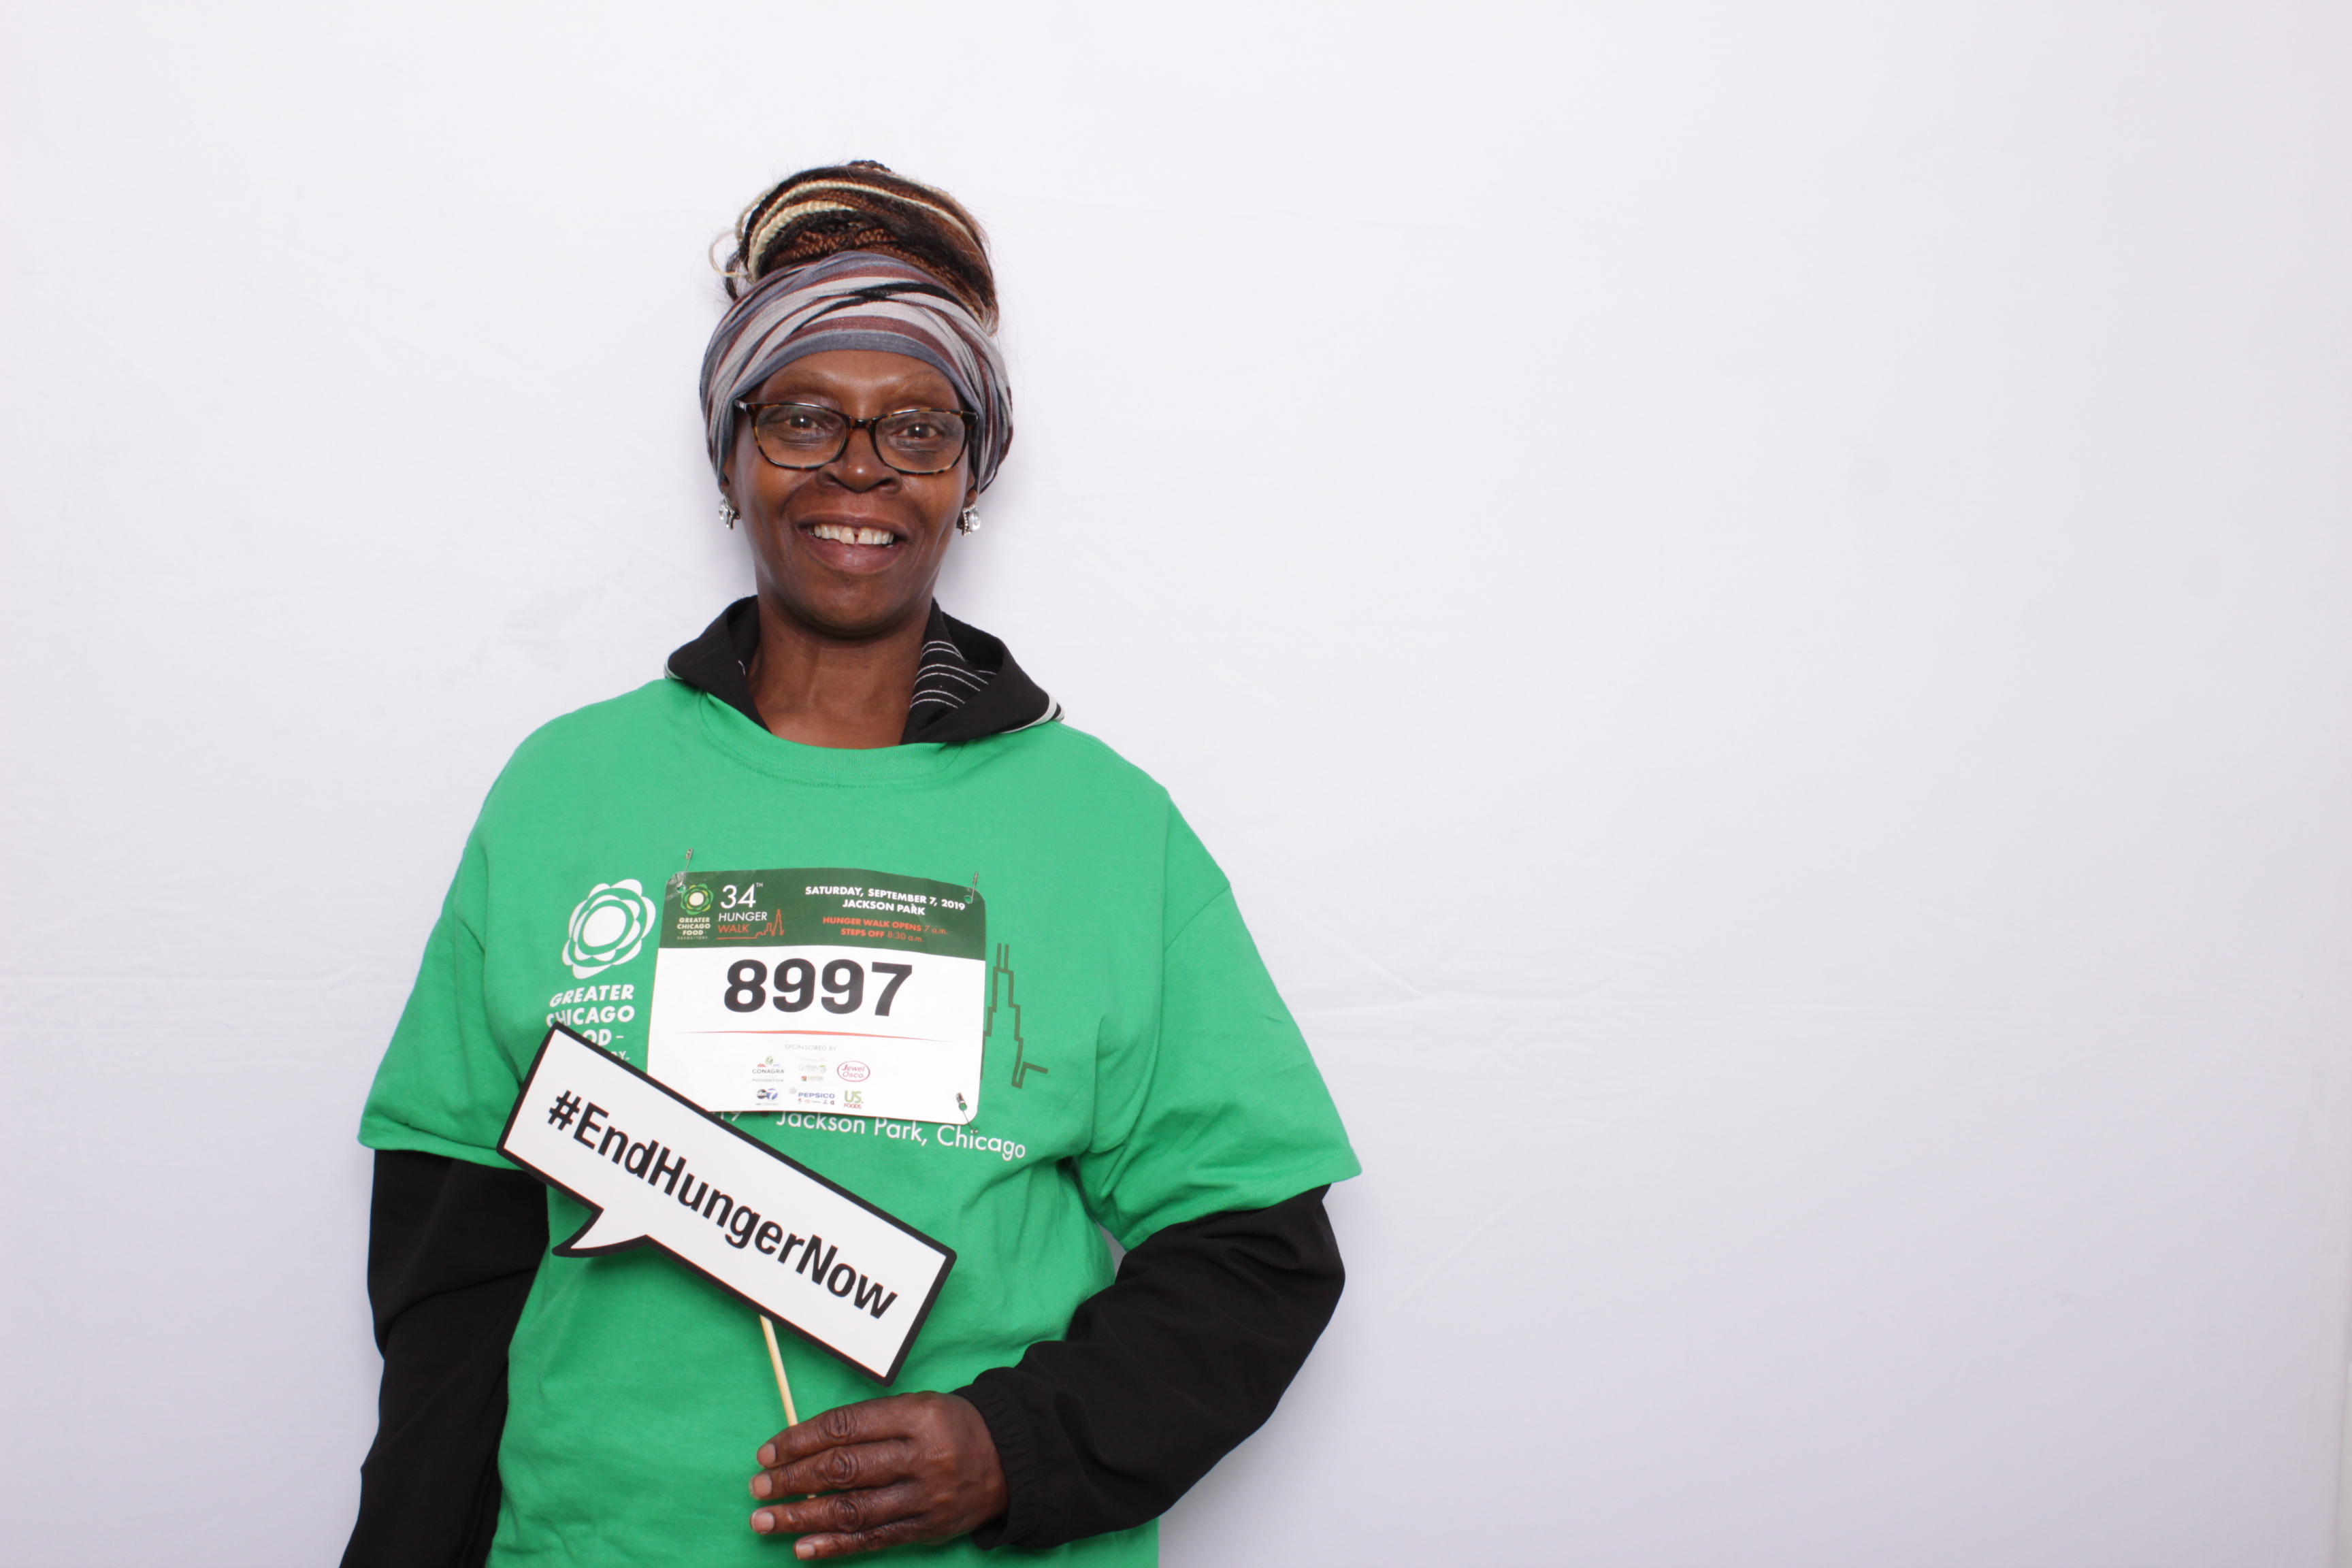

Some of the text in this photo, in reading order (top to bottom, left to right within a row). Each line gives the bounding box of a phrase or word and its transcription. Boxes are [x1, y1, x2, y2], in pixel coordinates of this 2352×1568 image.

[805, 886, 965, 911] SATURDAY, SEPTEMBER 7, 2019
[843, 899, 925, 915] JACKSON PARK
[719, 911, 768, 921] HUNGER
[822, 917, 861, 926] HUNGER
[864, 919, 889, 928] WALK
[892, 921, 921, 932] OPENS
[932, 927, 948, 935] a.m.
[718, 924, 750, 932] WALK
[840, 928, 866, 936] STEPS
[868, 930, 885, 938] OFF
[887, 931, 906, 940] 8:30
[549, 984, 634, 1007] GREATER
[723, 958, 913, 1017] 8997
[546, 1005, 635, 1028] CHICAGO
[842, 1064, 865, 1072] Jewel
[777, 1111, 1026, 1161] Jackson Park, Chicago
[547, 1090, 898, 1319] #EndHungerNow
